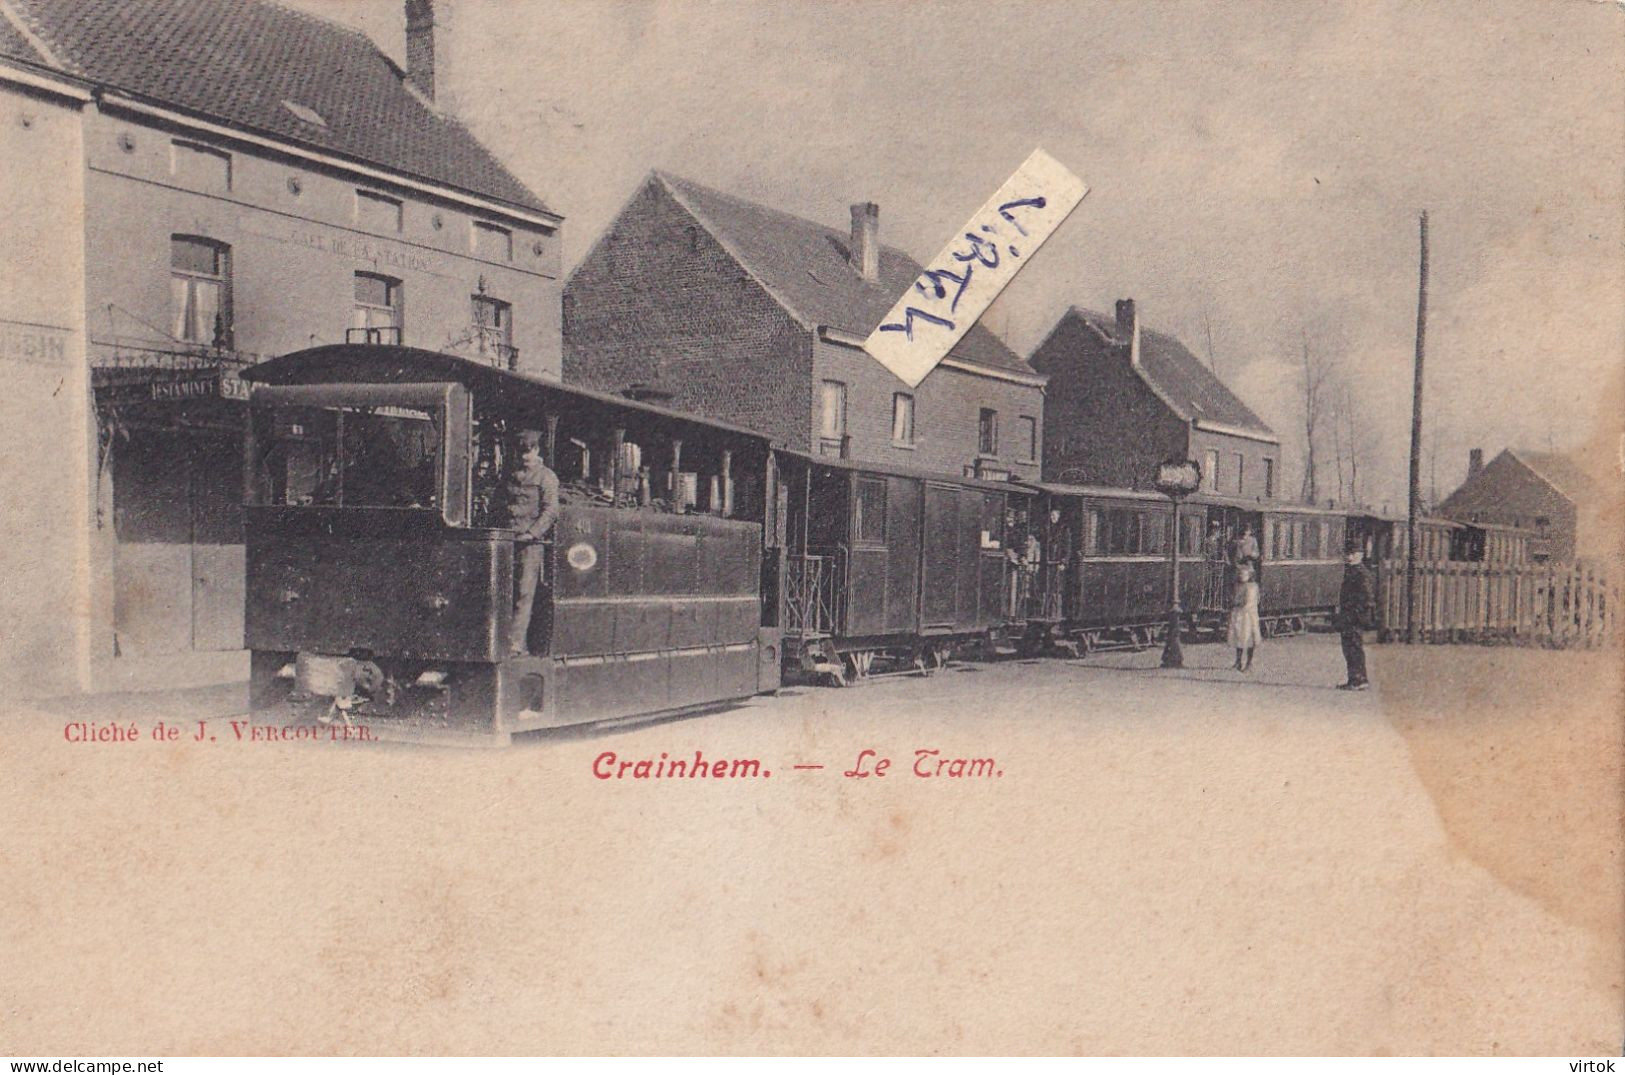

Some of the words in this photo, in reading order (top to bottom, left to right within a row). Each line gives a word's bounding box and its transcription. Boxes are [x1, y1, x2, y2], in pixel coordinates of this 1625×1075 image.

[64, 722, 139, 742] Cliché
[152, 722, 180, 742] de
[194, 721, 217, 742] J.
[592, 751, 771, 780] Crainhem.
[844, 750, 891, 779] Le
[912, 749, 1004, 778] Tram.
